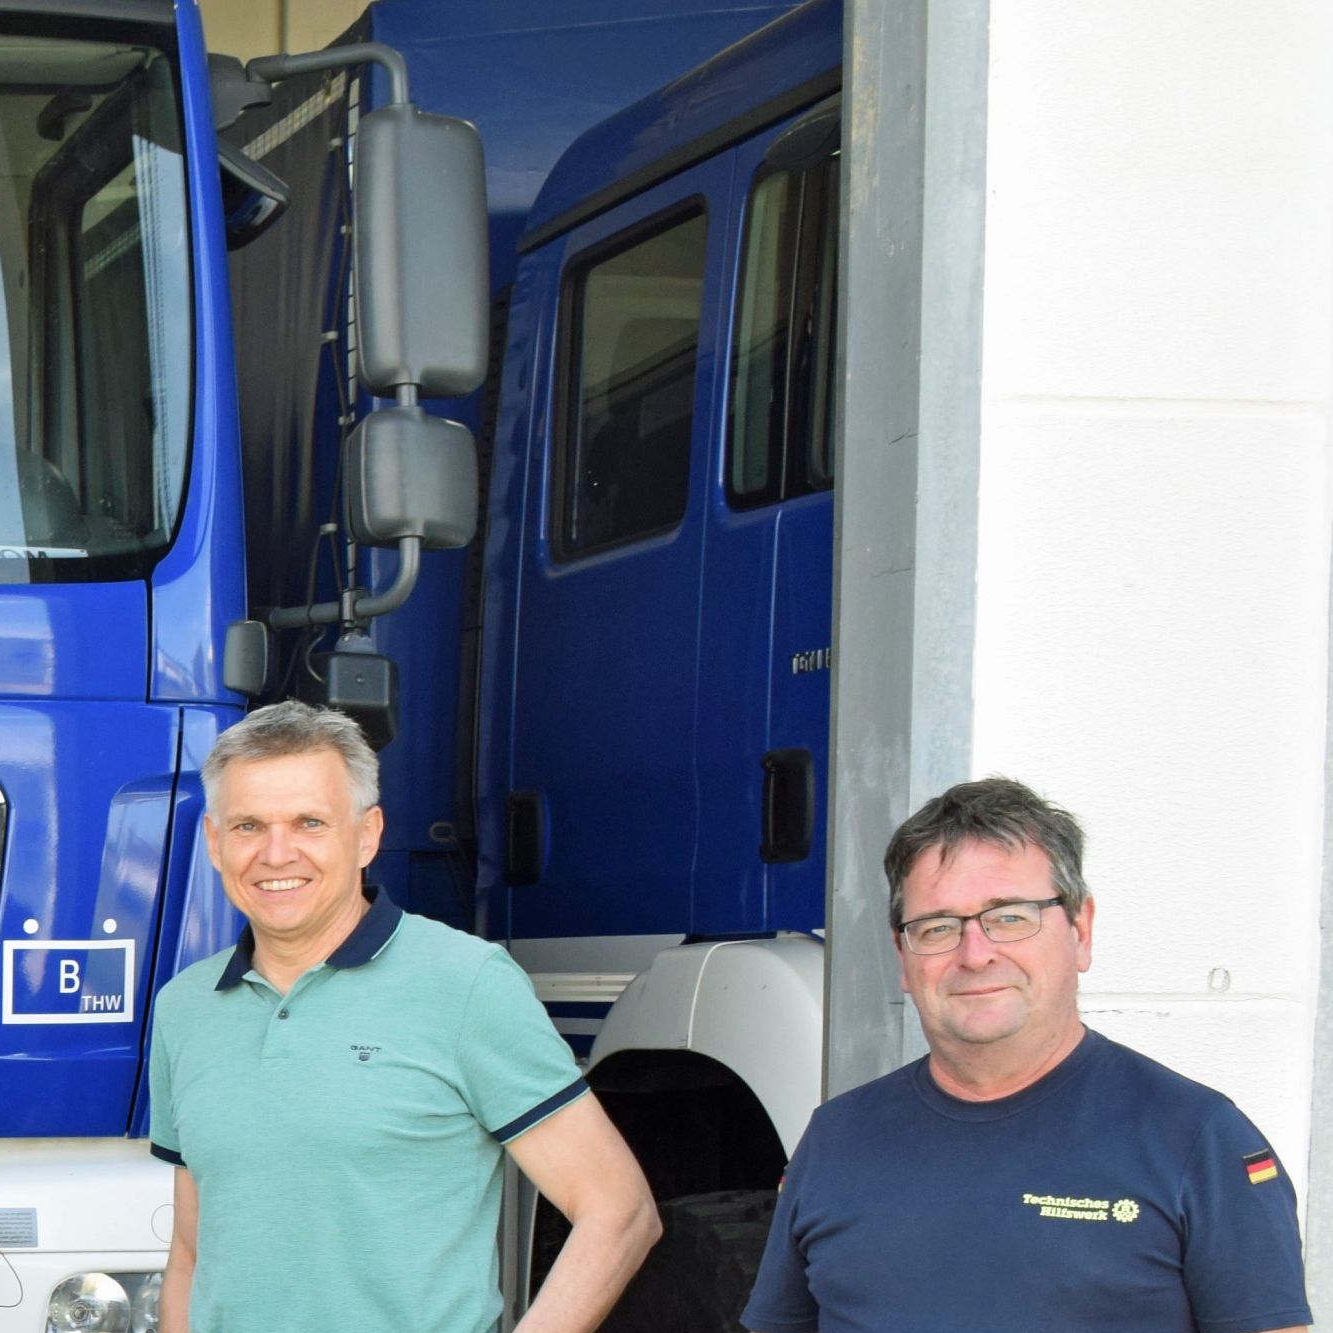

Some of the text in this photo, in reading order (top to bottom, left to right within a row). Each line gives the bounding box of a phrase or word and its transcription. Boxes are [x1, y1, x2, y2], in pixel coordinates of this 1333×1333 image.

[59, 959, 81, 994] B
[81, 995, 121, 1011] THW
[1022, 1193, 1110, 1210] Technisches
[1040, 1206, 1108, 1221] Hilfswerk
